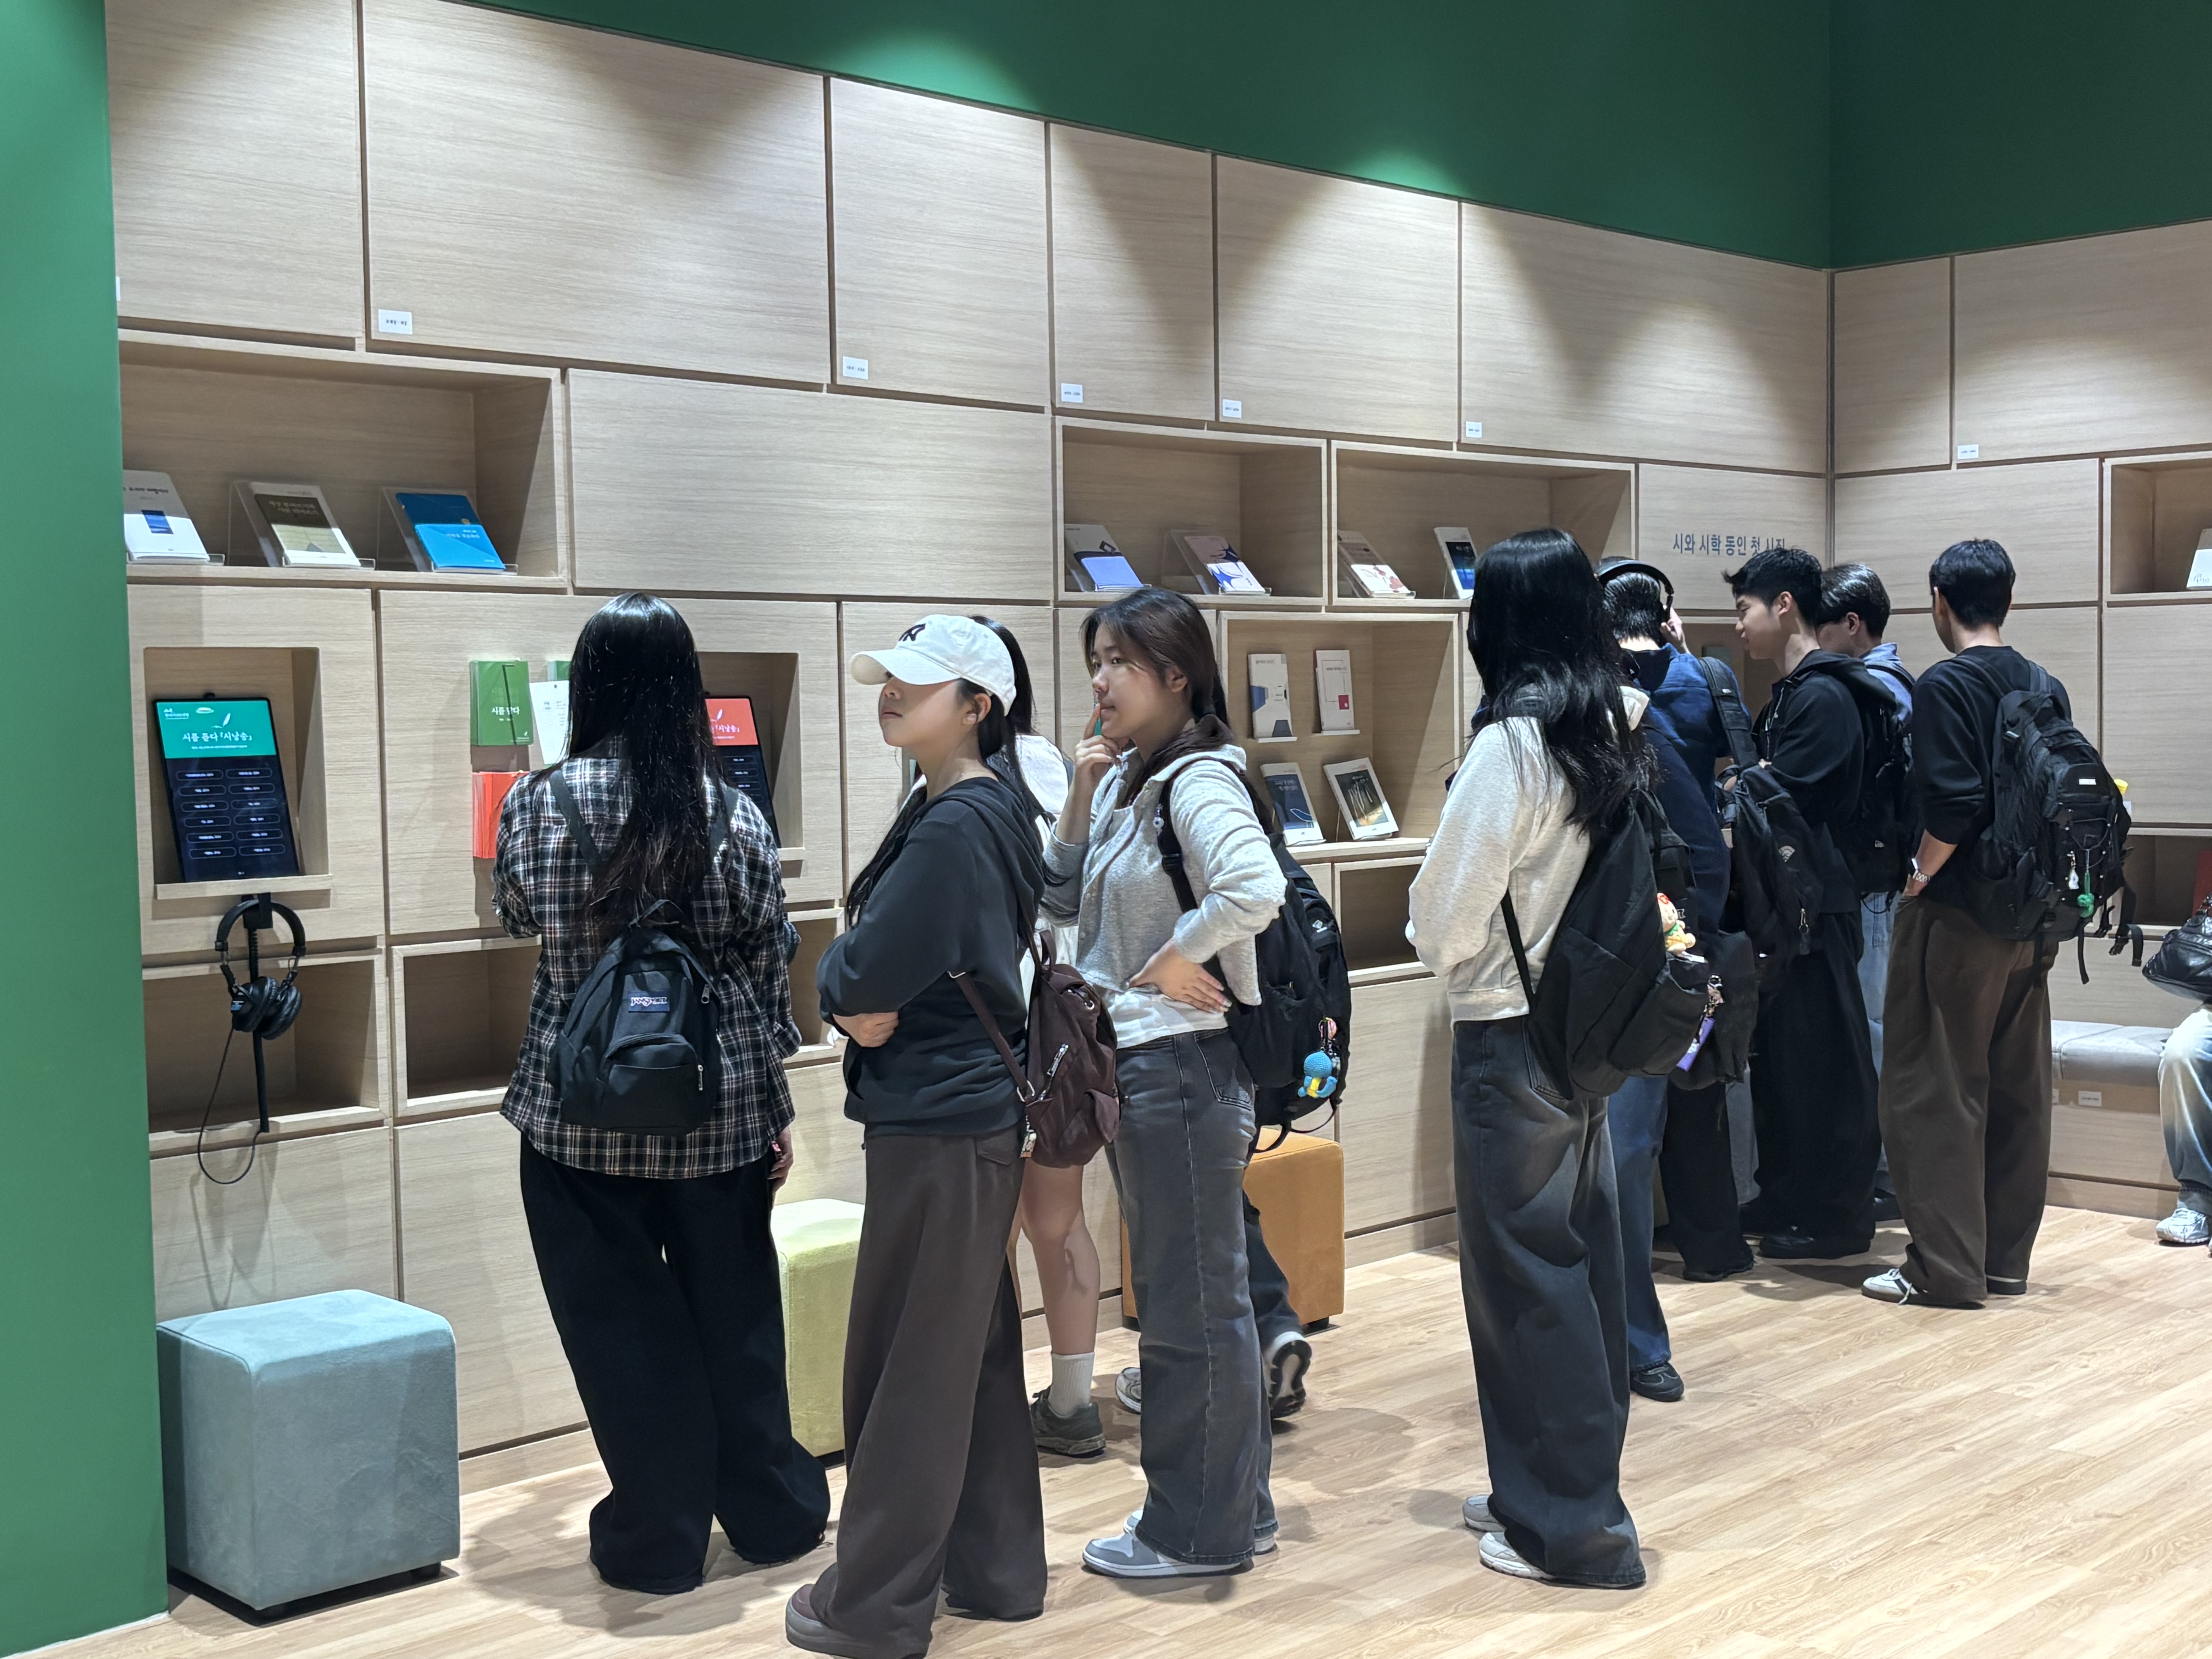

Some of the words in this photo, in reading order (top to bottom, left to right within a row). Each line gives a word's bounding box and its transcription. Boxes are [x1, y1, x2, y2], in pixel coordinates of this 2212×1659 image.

[1673, 533, 1695, 555] 시와
[1699, 534, 1721, 555] 시학
[1725, 536, 1746, 556] 동인
[1751, 536, 1760, 556] 첫
